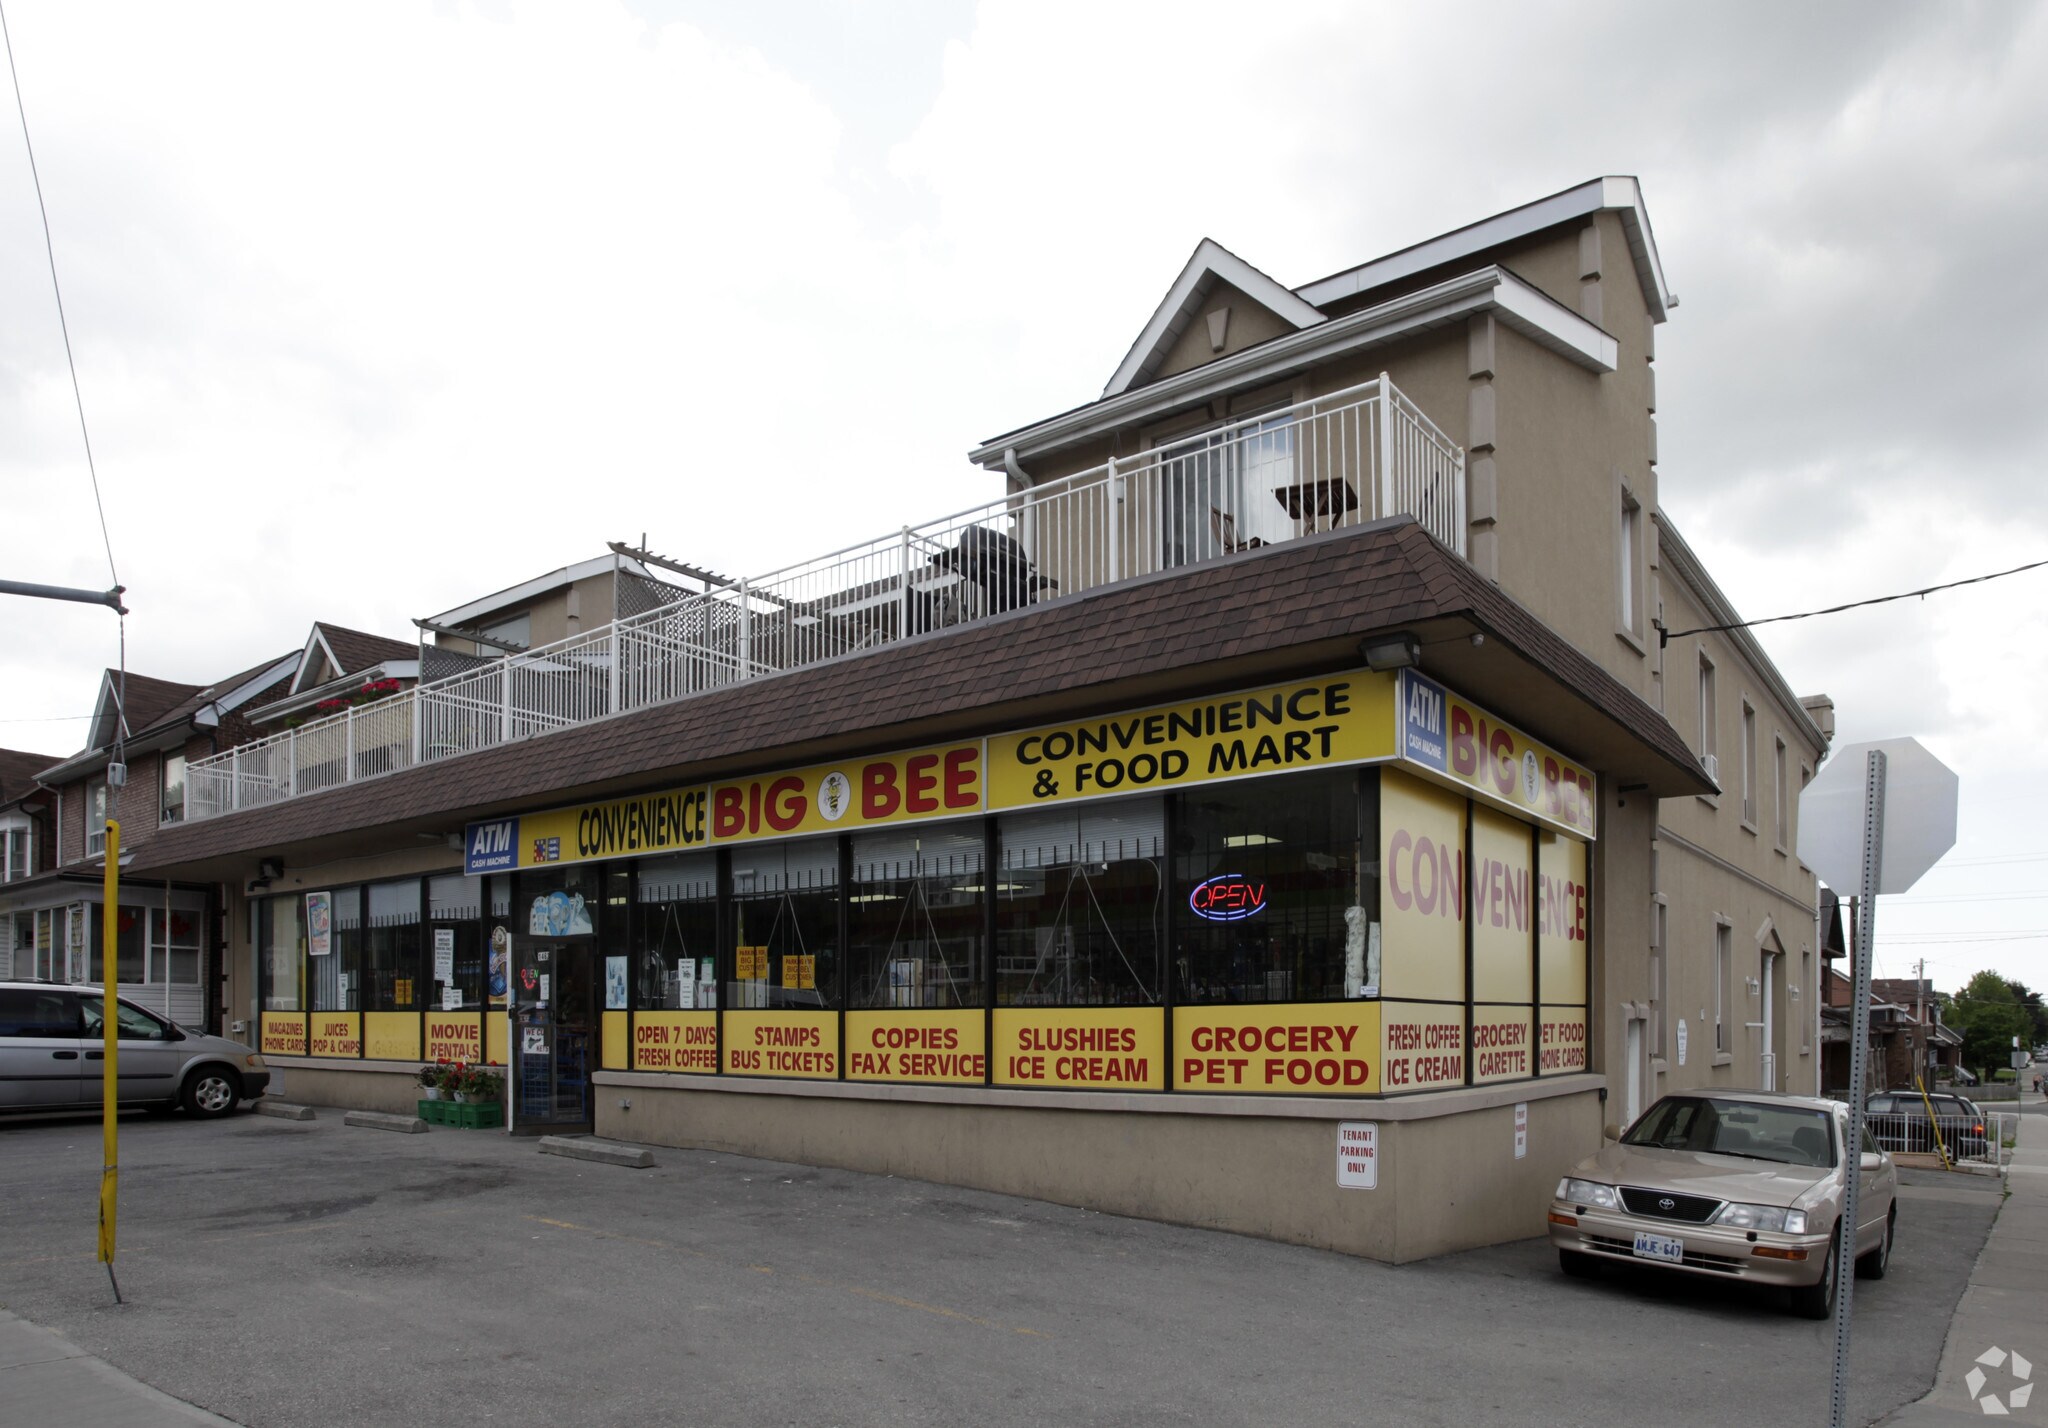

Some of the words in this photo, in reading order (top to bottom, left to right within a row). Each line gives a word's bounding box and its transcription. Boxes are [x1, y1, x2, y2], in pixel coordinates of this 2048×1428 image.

[1409, 681, 1440, 736] ATM
[1017, 683, 1351, 766] CONVENIENCE
[1408, 732, 1422, 750] CASH
[1422, 738, 1441, 760] MACHINE
[1032, 769, 1059, 800] &
[1075, 750, 1189, 793] FOOD
[1207, 725, 1340, 774] MART
[1452, 705, 1516, 795] BIG
[1545, 756, 1592, 830] BEE
[714, 776, 807, 838] BIG
[861, 748, 979, 819] BEE
[578, 791, 705, 857] CONVENIENCE
[472, 822, 512, 855] ATM
[471, 859, 486, 869] CASH
[486, 856, 511, 867] MACHINE
[1193, 883, 1265, 909] OPEN
[1389, 829, 1585, 941] CONVENIENCE
[521, 968, 539, 979] OEN
[787, 965, 799, 973] BIG
[268, 1022, 304, 1036] MAGAZINES
[323, 1023, 349, 1037] JUICES
[431, 1024, 479, 1040] MOVIE
[525, 1028, 536, 1036] WE
[636, 1025, 669, 1045] OPEN
[673, 1026, 682, 1044] 7
[685, 1026, 717, 1045] DAYS
[754, 1026, 820, 1047] STAMPS
[871, 1027, 959, 1049] COPIES
[1018, 1027, 1136, 1052] SLUSHIES
[1190, 1025, 1359, 1053] GROCERY
[1388, 1024, 1422, 1051] FRESH
[1424, 1024, 1460, 1049] COFFEE
[1472, 1023, 1528, 1050] GROCERY
[1558, 1023, 1584, 1043] FOOD
[264, 1037, 285, 1050] PHONE
[286, 1038, 308, 1052] CARDS
[313, 1039, 329, 1052] POP
[330, 1040, 336, 1053] &
[337, 1040, 361, 1054] CHIPS
[430, 1042, 480, 1059] RENTALS
[637, 1048, 671, 1067] FRESH
[674, 1048, 717, 1068] COFFEE
[730, 1050, 761, 1070] BUS
[765, 1050, 835, 1073] TICKETS
[851, 1052, 891, 1075] FAX
[899, 1053, 985, 1078] SERVICE
[1009, 1056, 1046, 1079] ICE
[1055, 1057, 1148, 1082] CREAM
[1479, 1050, 1526, 1077] GARETTE
[1540, 1048, 1560, 1070] HONE
[1562, 1047, 1585, 1068] CARDS
[1183, 1058, 1249, 1084] PET
[1264, 1058, 1370, 1086] FOOD
[1387, 1058, 1410, 1086] ICE
[1415, 1055, 1461, 1083] CREAM
[1342, 1129, 1373, 1142] TENANT
[1340, 1146, 1374, 1158] PARKING
[1347, 1162, 1366, 1174] ONLY
